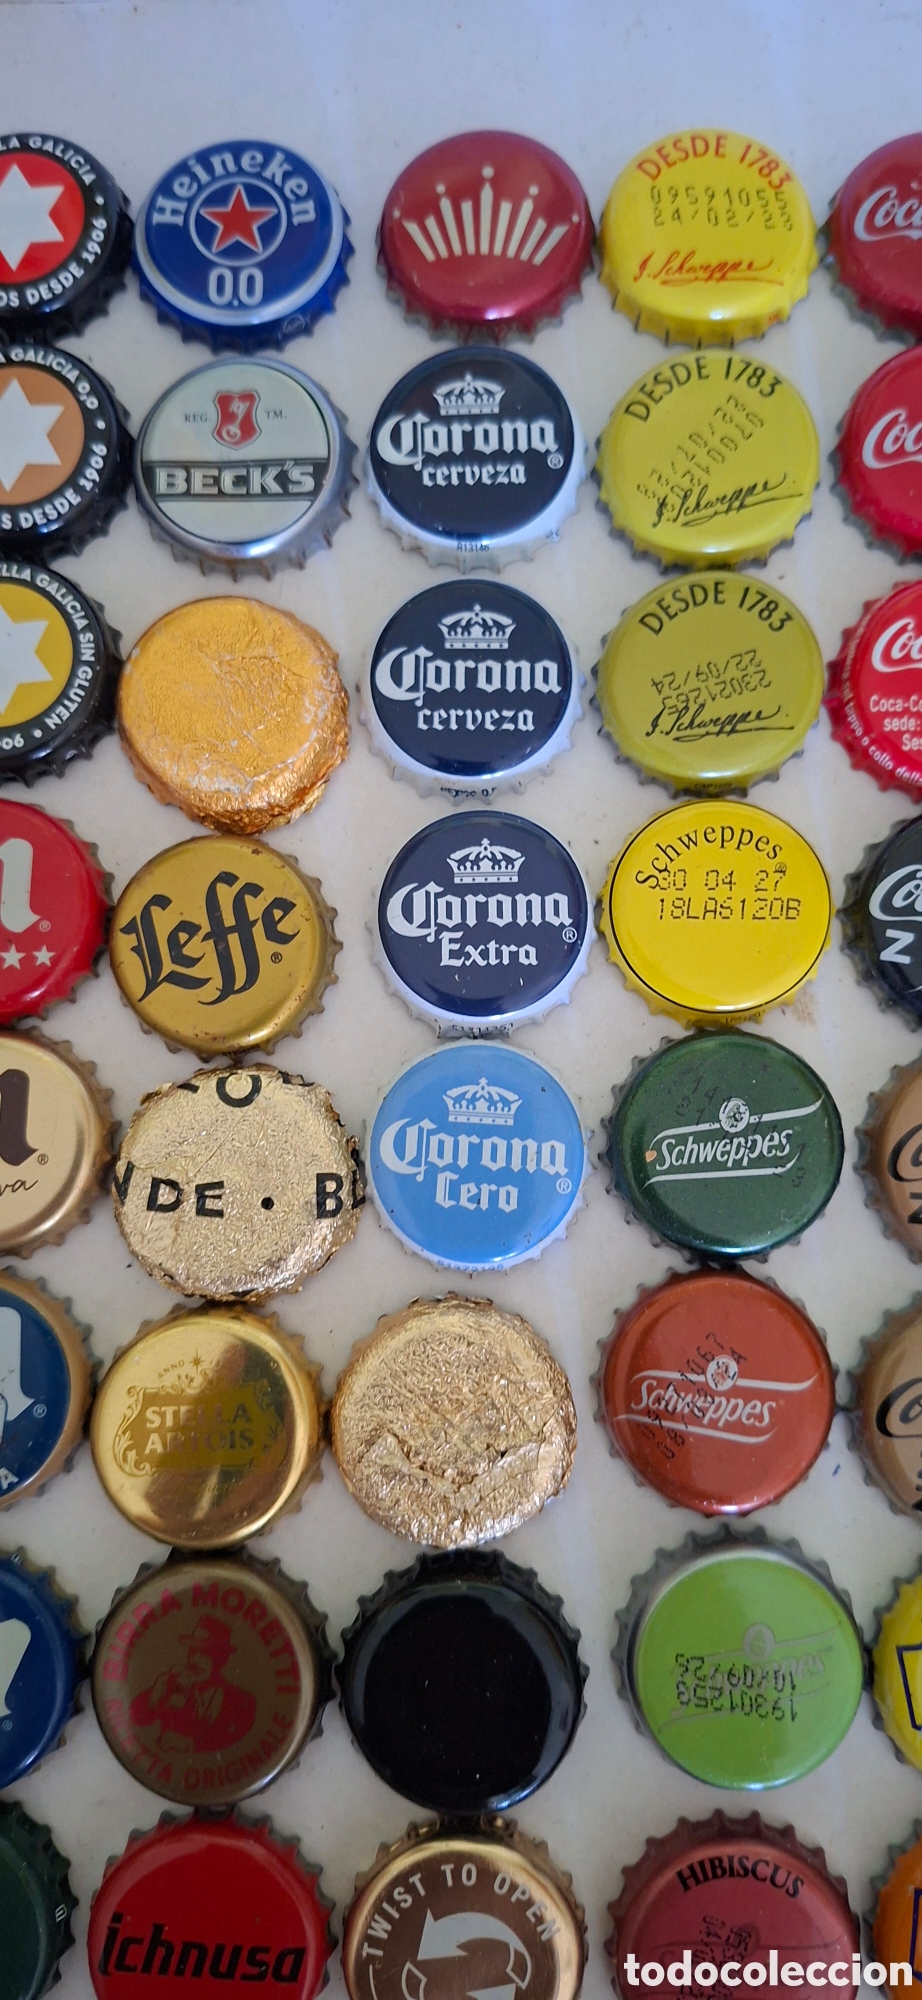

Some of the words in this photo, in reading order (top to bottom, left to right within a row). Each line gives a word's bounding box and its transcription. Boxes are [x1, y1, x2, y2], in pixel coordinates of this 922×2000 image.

[29, 136, 97, 186] GALICIA
[636, 134, 728, 182] DESDE
[739, 144, 793, 190] 1783
[153, 150, 317, 227] Heineken
[26, 262, 85, 305] DESDE
[82, 216, 108, 264] 1906
[208, 266, 264, 307] 0.0
[10, 348, 80, 384] GALICIA
[624, 356, 710, 423] DESDE
[724, 357, 783, 398] 1783
[184, 413, 212, 424] REG.
[264, 409, 287, 420] TM.
[376, 411, 559, 471] Corona
[19, 488, 82, 529] DESDE
[79, 443, 107, 492] 1906
[156, 460, 315, 495] BECK'S
[422, 463, 527, 488] cerveza
[36, 574, 90, 631] GALICIA
[638, 580, 726, 636] DESDE
[738, 586, 794, 632] 1783
[79, 633, 96, 662] SIN
[45, 667, 93, 730] GLUTEN
[375, 644, 563, 707] Corona
[416, 707, 535, 732] cerveza
[868, 746, 894, 771] collo
[635, 825, 783, 891] Schweppes
[704, 869, 737, 892] 04
[386, 880, 574, 943] Corona
[119, 871, 301, 1006] Leffe
[438, 930, 538, 967] Extra
[379, 1116, 570, 1182] Corona
[656, 1128, 793, 1172] Schweppes
[435, 1170, 519, 1214] Cero
[158, 1359, 186, 1379] ANNO
[145, 1402, 252, 1428] STELLA
[631, 1378, 777, 1427] Schweppes
[143, 1428, 255, 1455] ARTOIS
[103, 1587, 183, 1682] BIRRA
[191, 1581, 302, 1695] MORETTI
[105, 1698, 173, 1784] RICETTA
[183, 1712, 295, 1791] ORIGINALE
[675, 1854, 805, 1899] HIBISCUS
[362, 1872, 427, 1959] TWIST
[441, 1863, 477, 1887] TO
[493, 1872, 561, 1943] OPEN
[98, 1911, 307, 1984] ichnusa
